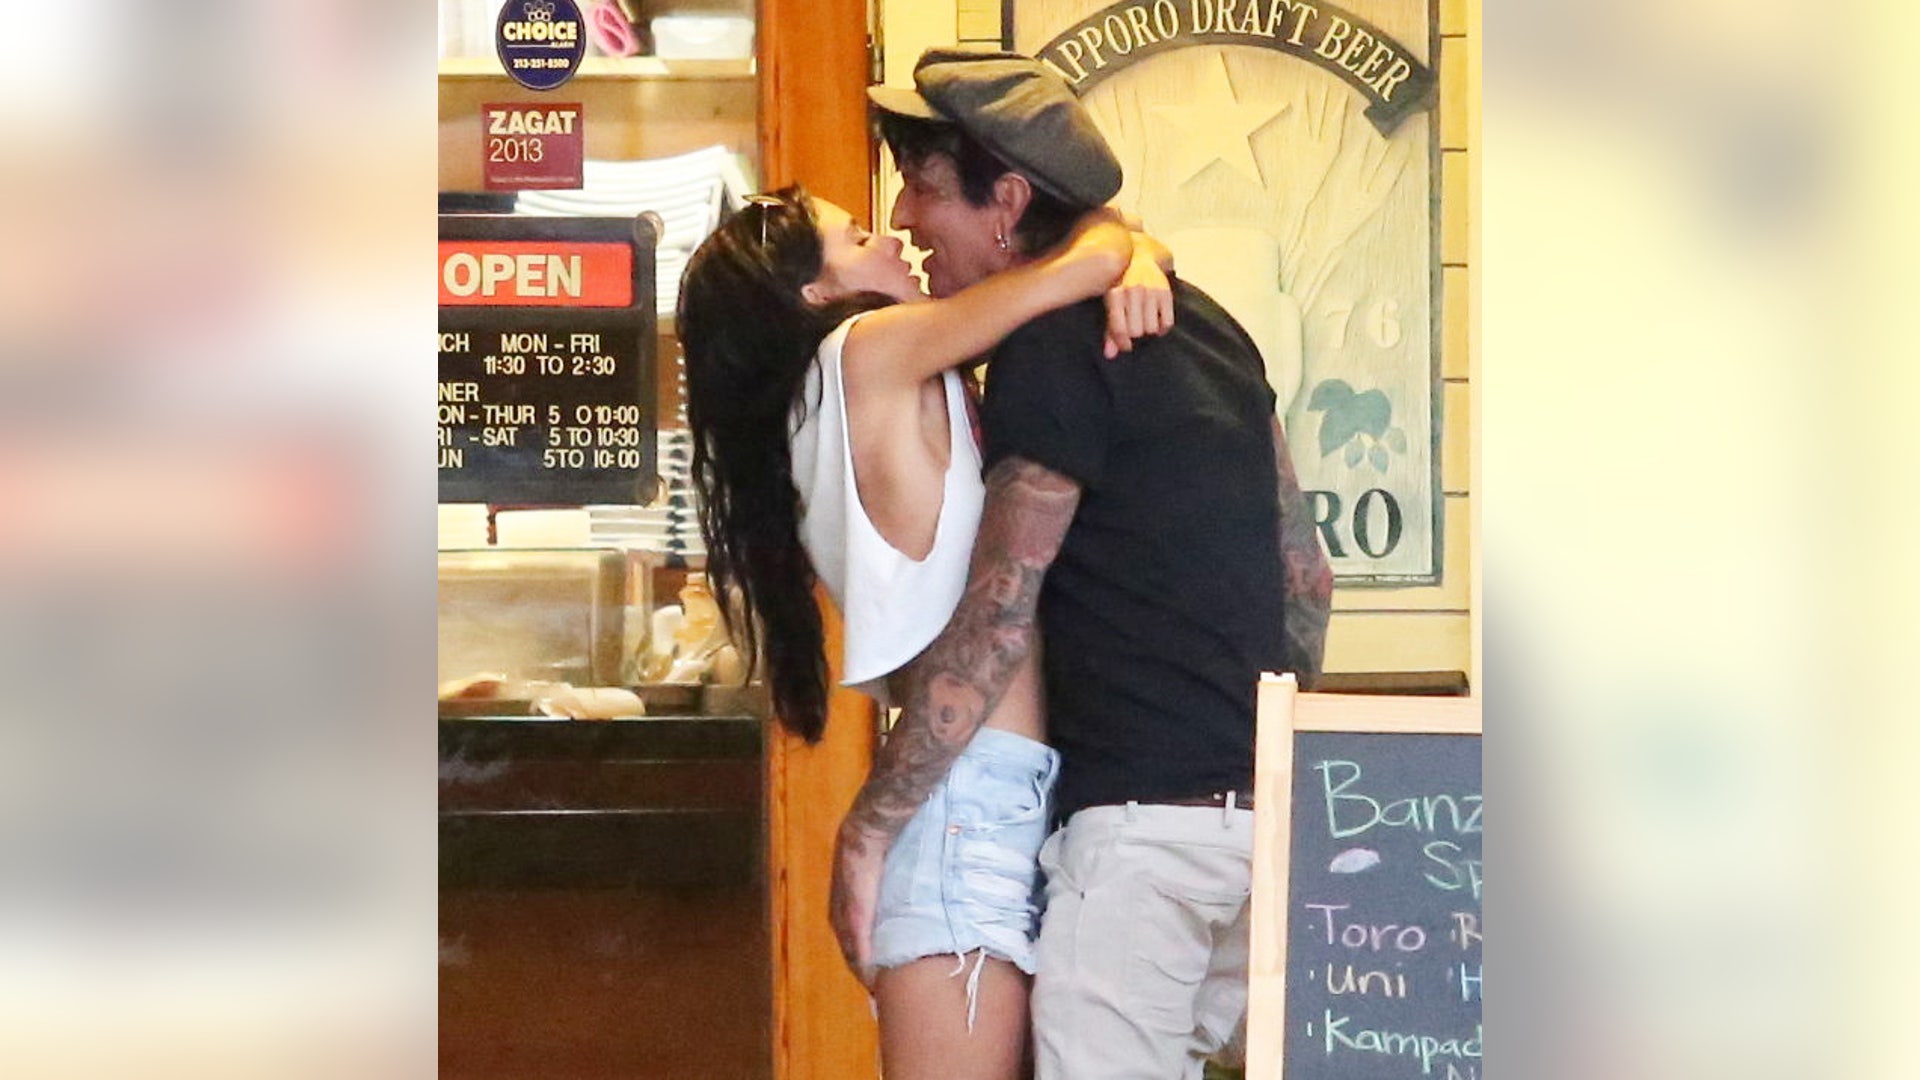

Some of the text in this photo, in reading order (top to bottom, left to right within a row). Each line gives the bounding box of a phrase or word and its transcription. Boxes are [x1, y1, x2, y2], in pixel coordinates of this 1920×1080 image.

[503, 21, 577, 41] CHOICE
[1191, 0, 1318, 46] DRAFT
[1315, 15, 1411, 102] BEER
[489, 111, 577, 135] ZAGAT
[489, 138, 543, 162] 2013
[443, 252, 582, 297] OPEN
[501, 333, 548, 353] MON
[570, 334, 601, 353] FRI
[483, 355, 616, 375] 11:30 TO 2:30
[438, 382, 479, 402] NER
[482, 405, 535, 424] THUR
[548, 405, 561, 424] 5
[595, 405, 640, 424] 10:00
[483, 427, 518, 446] SAT
[549, 427, 561, 446] 5
[566, 427, 592, 446] TO
[597, 427, 640, 446] 10:30
[1305, 903, 1426, 951] Toro
